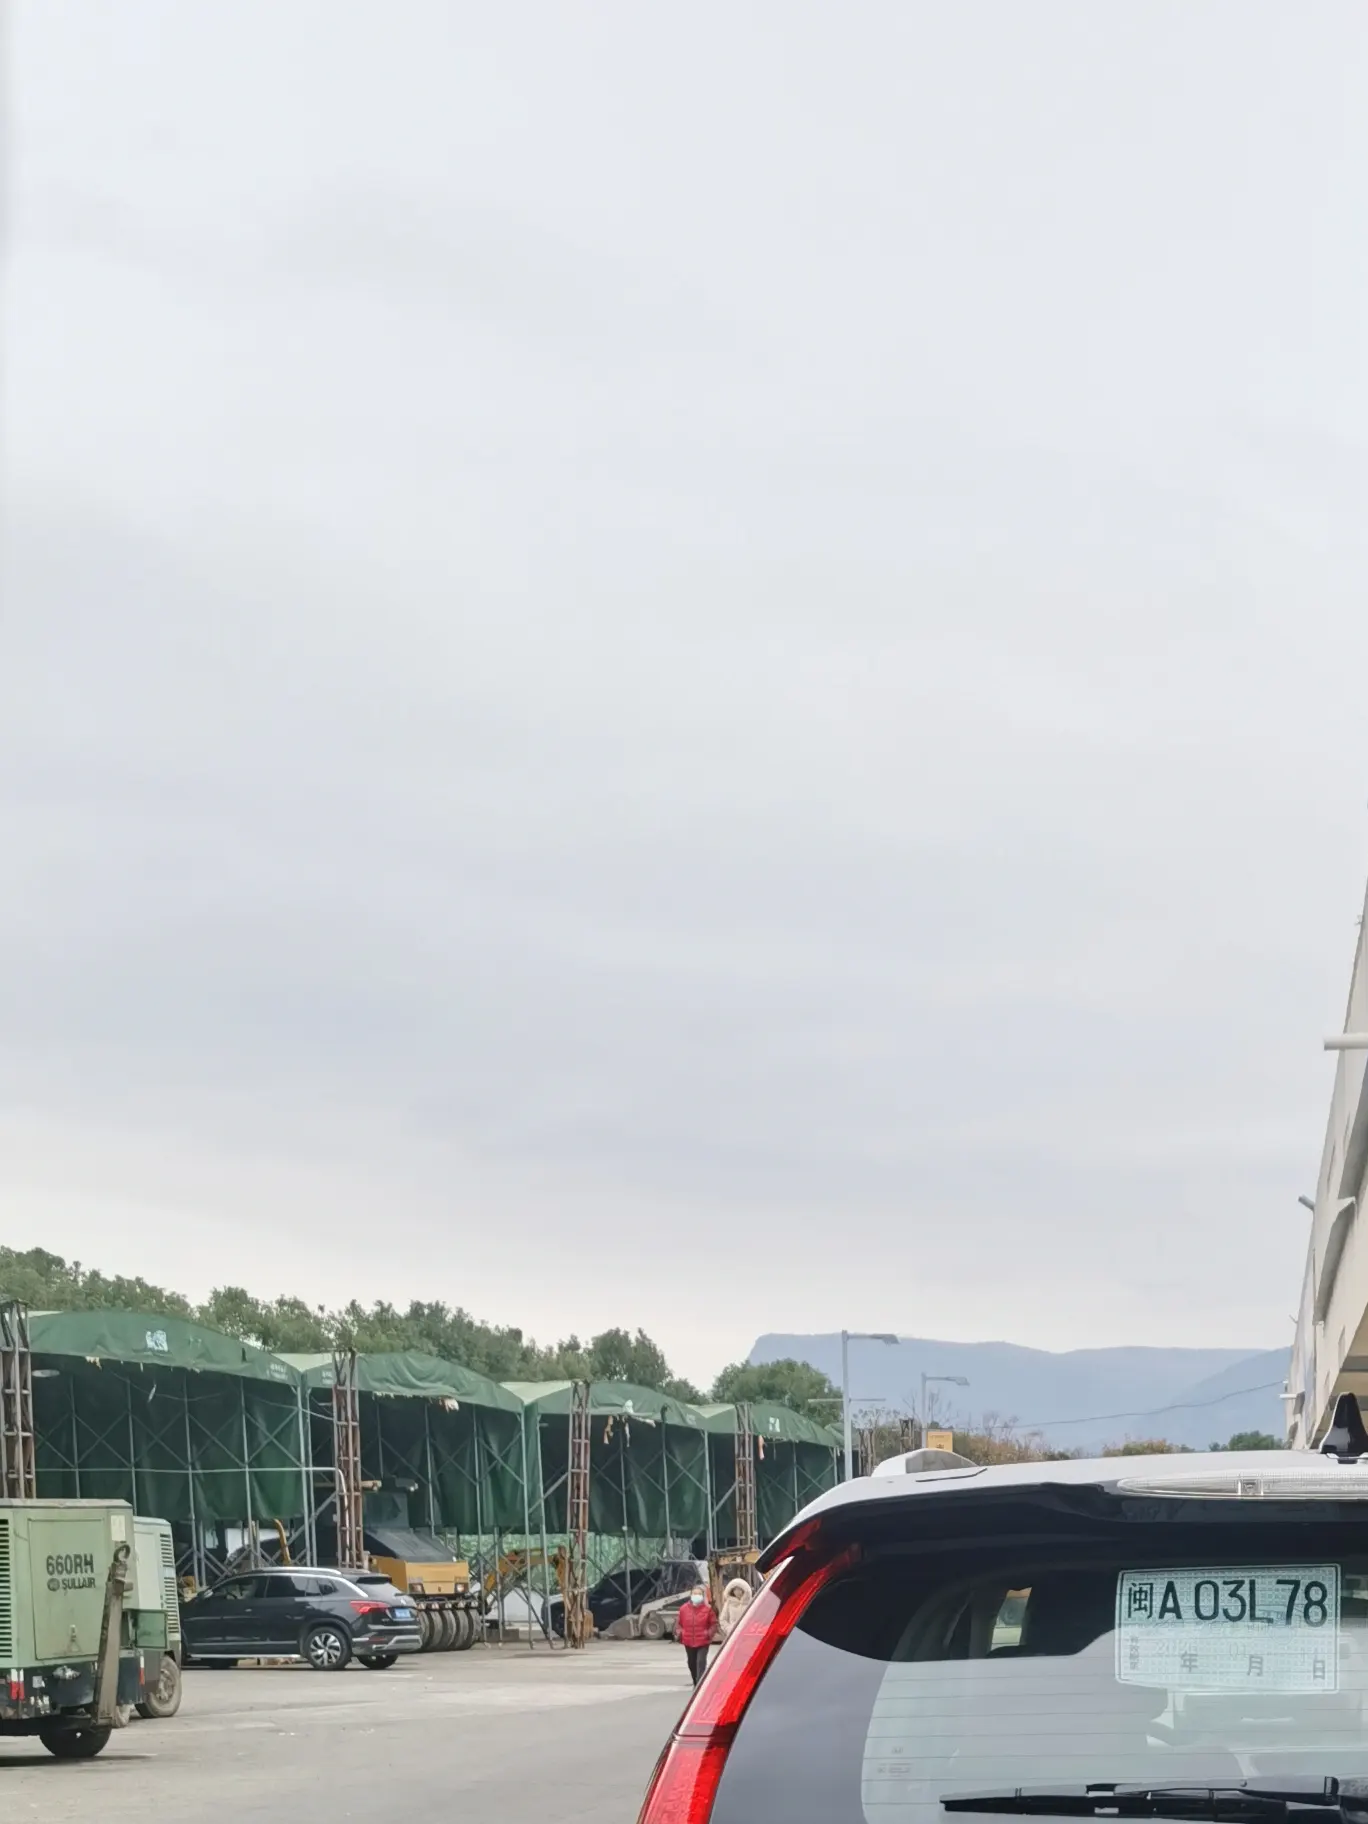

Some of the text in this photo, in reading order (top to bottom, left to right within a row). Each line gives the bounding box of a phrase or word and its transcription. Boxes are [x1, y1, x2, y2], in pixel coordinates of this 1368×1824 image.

[46, 1553, 94, 1575] 660RH
[61, 1577, 96, 1590] SULLAIR
[1181, 1651, 1198, 1673] 年
[1246, 1655, 1264, 1676] 月
